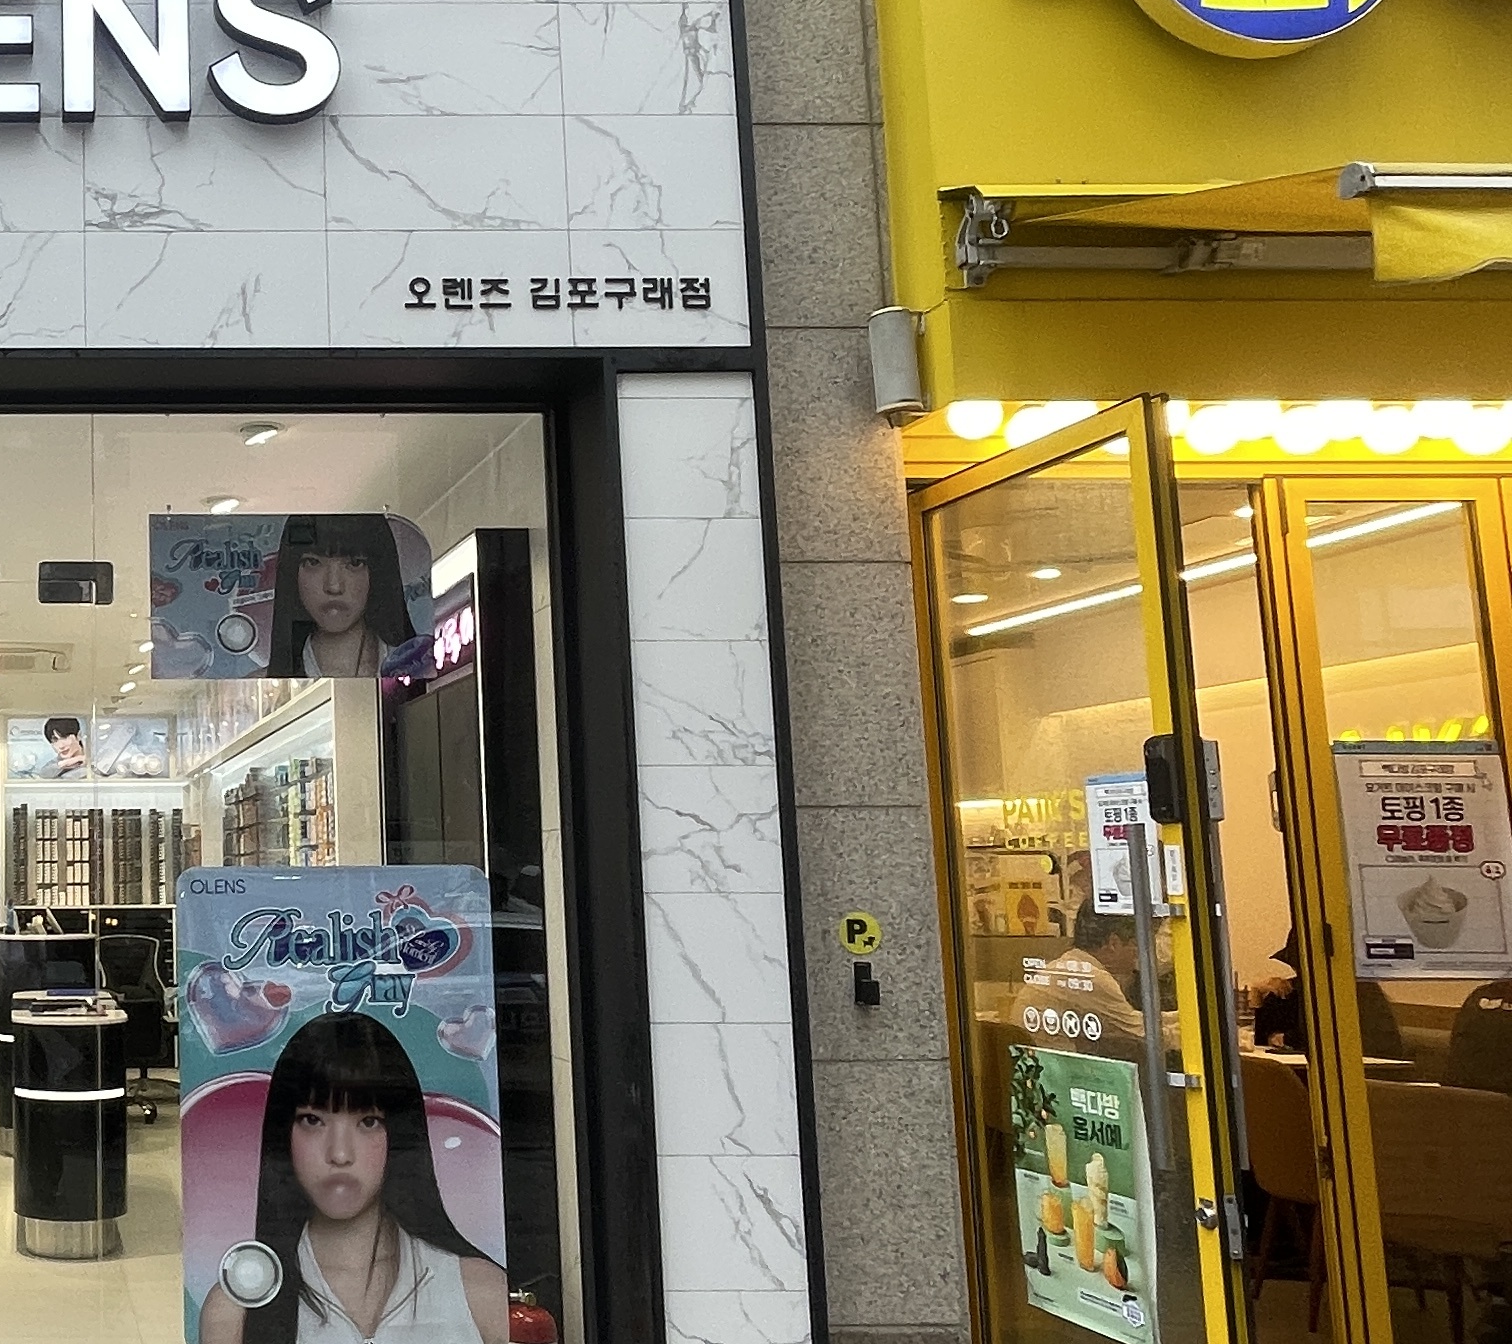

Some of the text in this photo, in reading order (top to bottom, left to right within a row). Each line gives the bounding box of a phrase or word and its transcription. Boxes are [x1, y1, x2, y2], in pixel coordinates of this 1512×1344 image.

[404, 276, 712, 312] 오렌즈 김포구래점
[1381, 795, 1465, 822] 토핑 1종
[189, 878, 246, 895] OLENS
[223, 907, 402, 971] Realish
[325, 959, 417, 1018] Gray
